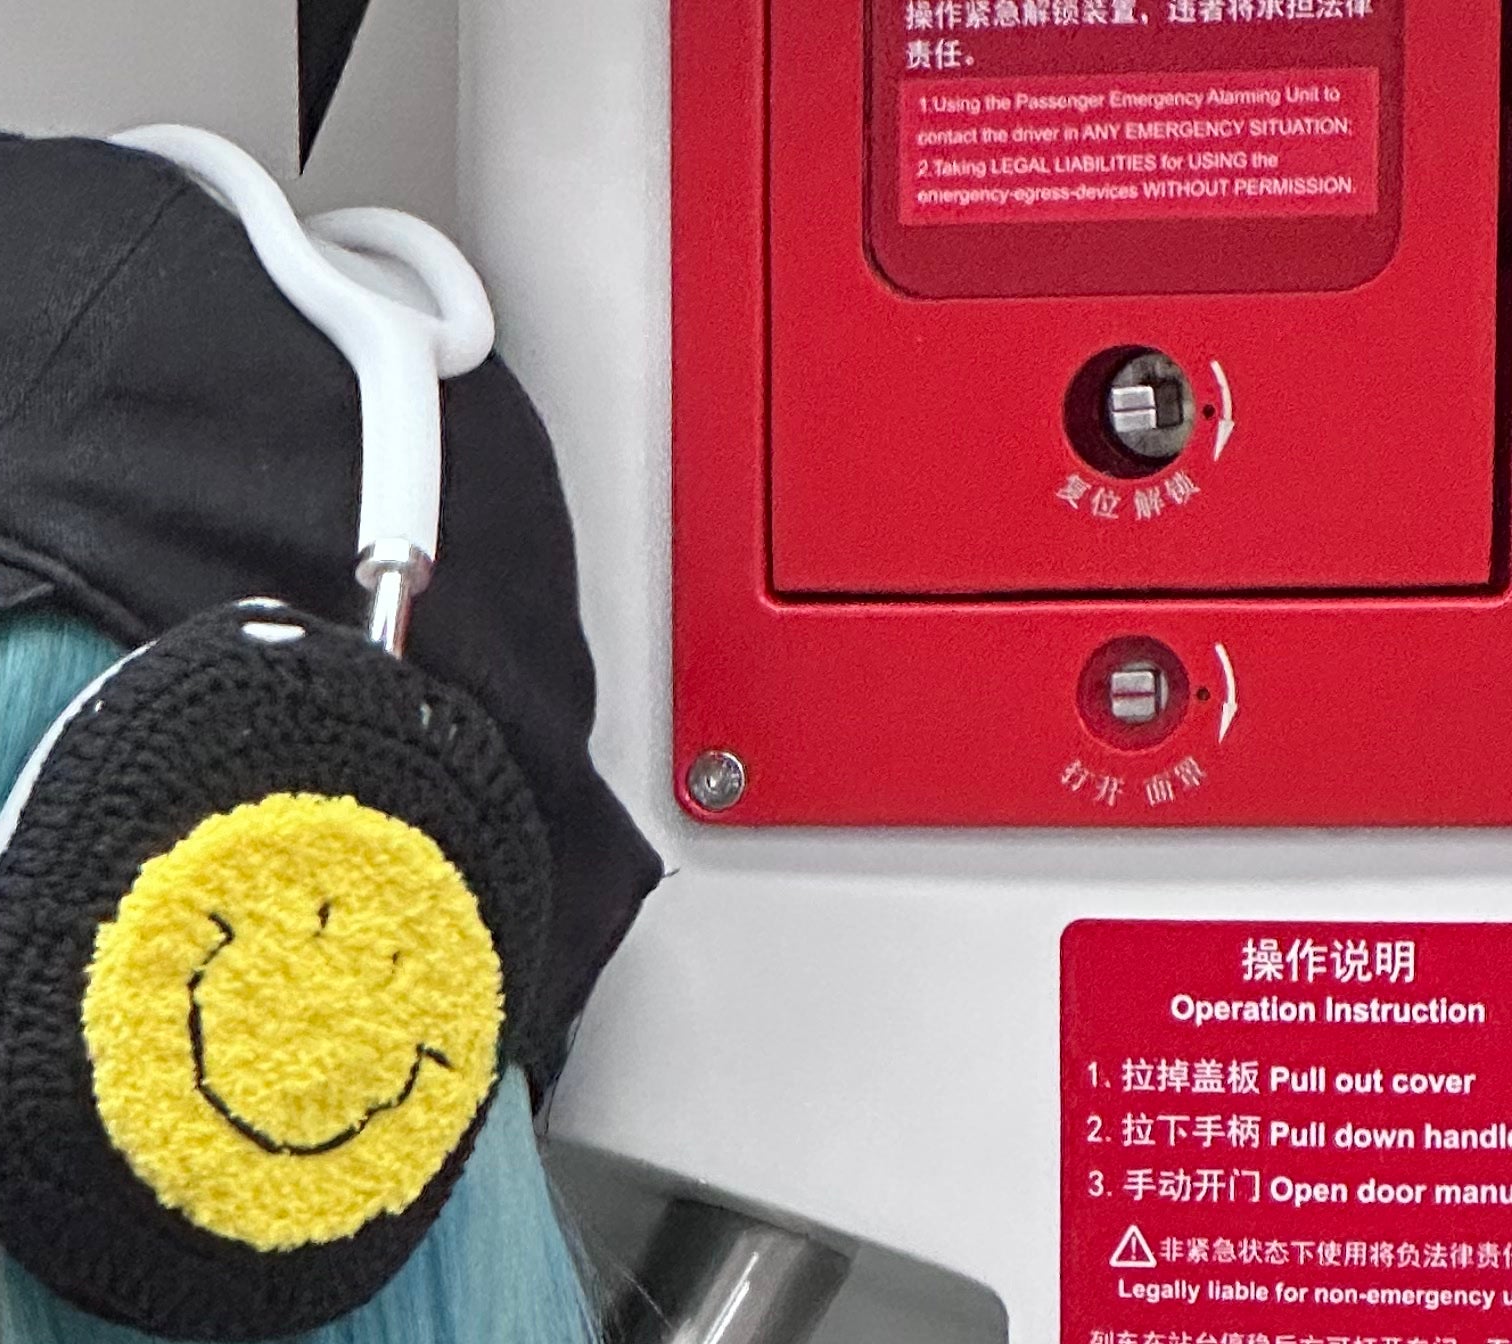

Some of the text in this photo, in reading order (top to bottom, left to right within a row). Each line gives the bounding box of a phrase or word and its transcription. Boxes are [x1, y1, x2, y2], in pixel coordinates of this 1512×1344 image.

[906, 39, 974, 70] 责任。
[984, 94, 1011, 111] the
[1015, 92, 1104, 113] Passenger
[1108, 89, 1204, 111] Emergency
[1206, 87, 1281, 107] Alarming
[1285, 86, 1320, 103] Unit
[1323, 86, 1341, 102] to
[917, 128, 978, 146] contact
[982, 127, 1008, 143] the
[1012, 126, 1059, 142] driver
[1063, 125, 1079, 141] in
[1082, 123, 1120, 140] ANY
[1125, 119, 1245, 140] EMERGENCY
[991, 156, 1050, 175] LEGAL
[1055, 153, 1157, 173] LIABILITIES
[1161, 153, 1184, 170] for
[1189, 151, 1247, 169] USING
[1252, 151, 1278, 168] the
[1143, 179, 1230, 199] WITHOUT
[1133, 471, 1201, 520] 解锁
[1241, 938, 1417, 983] 操作说明
[1170, 994, 1487, 1027] Operation Instruction
[1122, 1057, 1260, 1094] 拉掉盖板
[1270, 1066, 1327, 1092] Pull
[1335, 1068, 1384, 1094] out
[1392, 1072, 1477, 1094] cover
[1087, 1112, 1512, 1149] 2. 拉下手柄 Pull down handl
[1088, 1168, 1512, 1208] 3. 手动开门 Open door manu
[1118, 1279, 1200, 1304] Legally
[1208, 1280, 1269, 1302] liable
[1275, 1282, 1309, 1303] for
[1314, 1286, 1496, 1311] non-emergency
